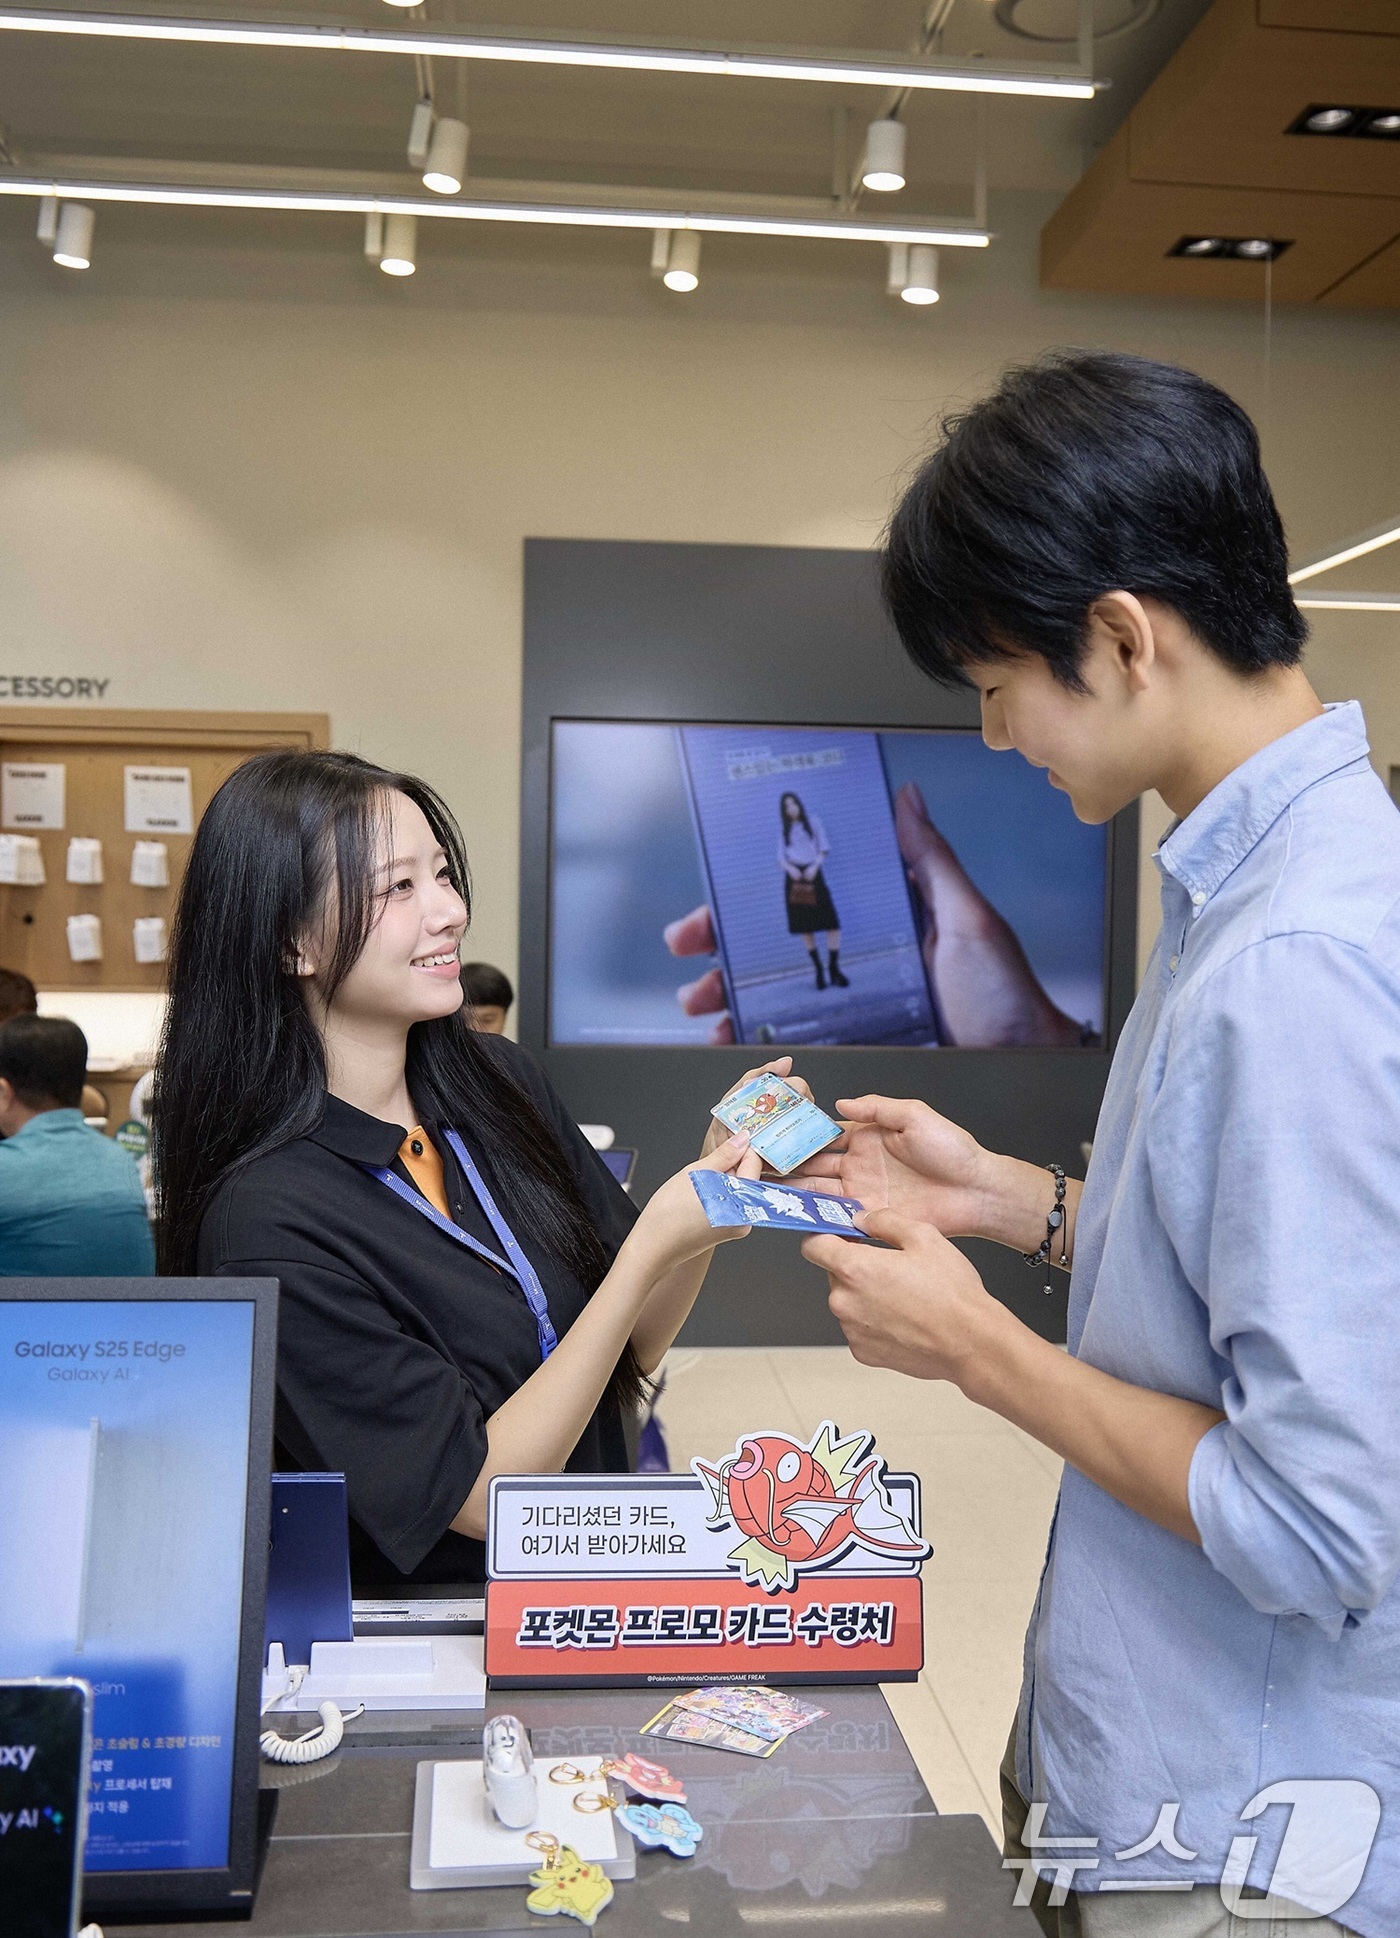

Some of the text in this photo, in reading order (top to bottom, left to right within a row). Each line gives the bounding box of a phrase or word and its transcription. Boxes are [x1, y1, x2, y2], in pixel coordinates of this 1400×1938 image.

[14, 1341, 186, 1362] Galaxy S25 Edge
[47, 1367, 129, 1384] Galaxy AI
[521, 1506, 675, 1528] 기다리셨던 카드,
[521, 1534, 686, 1555] 여기서 받아가세요
[518, 1606, 618, 1648] 포켓몬
[620, 1606, 723, 1646] 프로모
[726, 1603, 795, 1645] 카드
[796, 1602, 893, 1646] 수령처
[104, 1778, 147, 1791] 프로세서
[16, 1808, 38, 1828] AI
